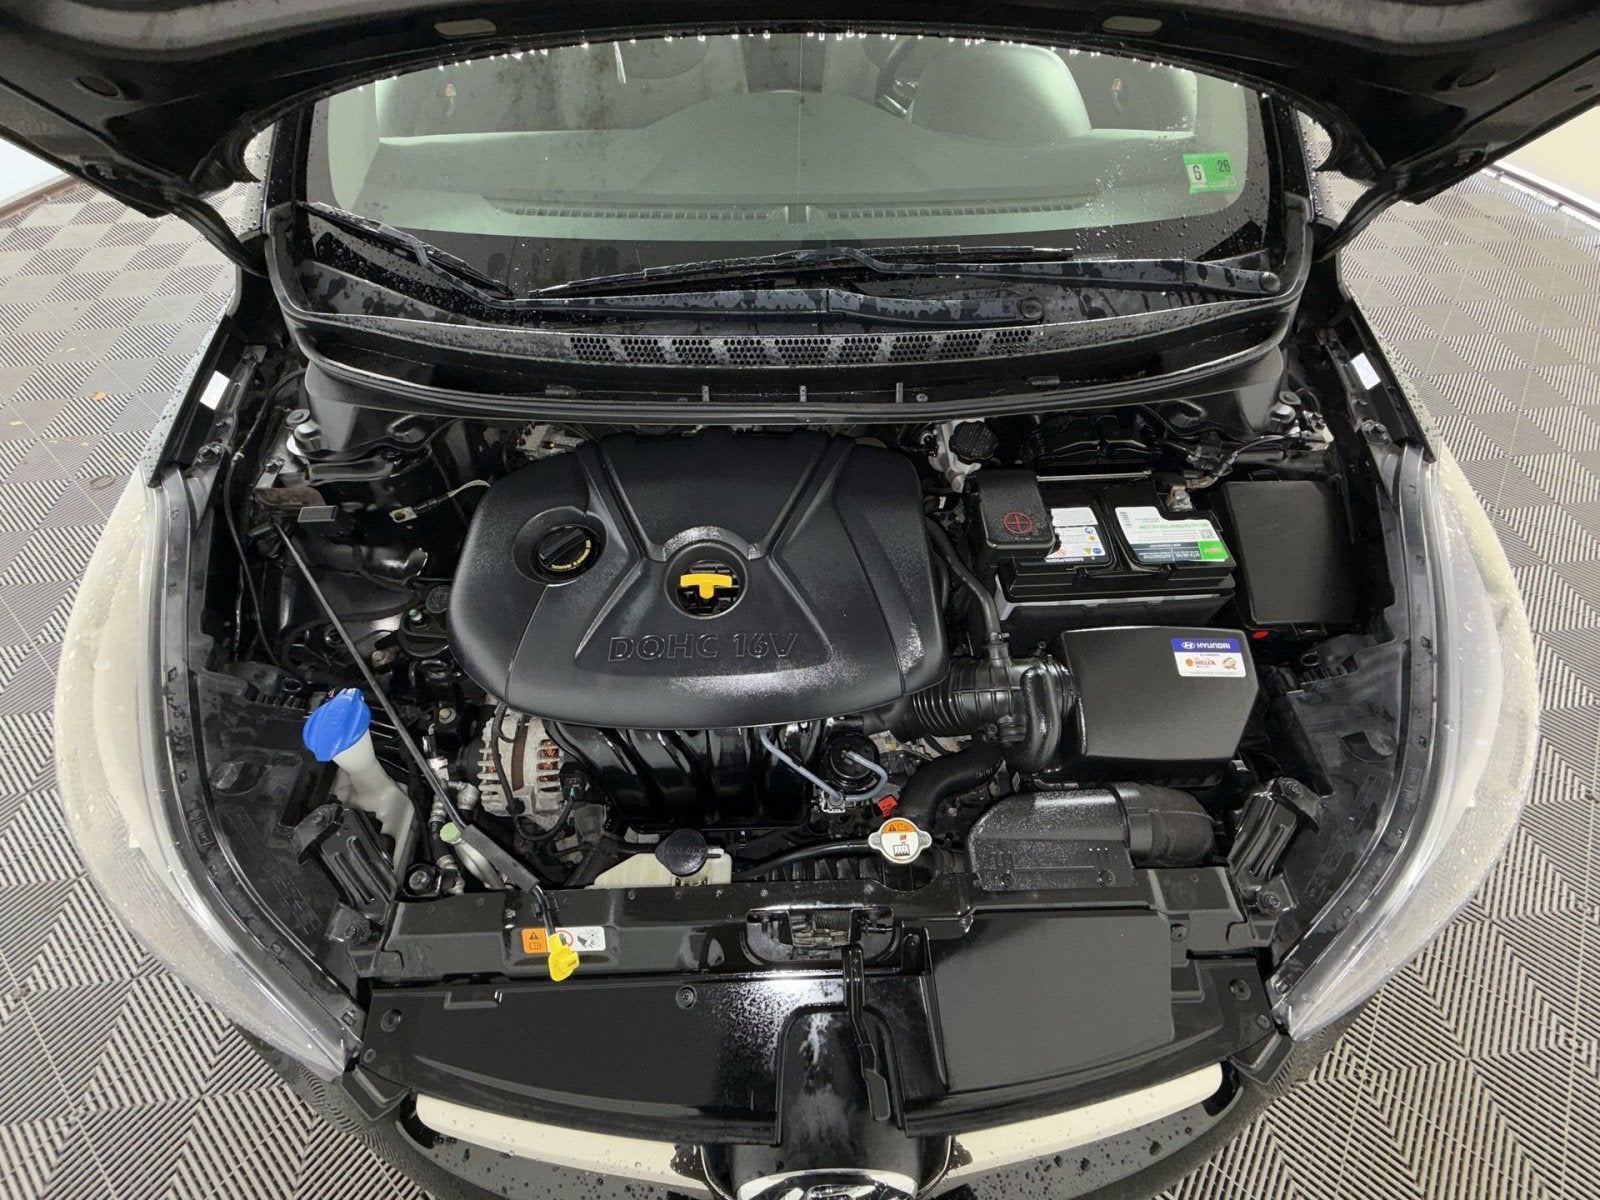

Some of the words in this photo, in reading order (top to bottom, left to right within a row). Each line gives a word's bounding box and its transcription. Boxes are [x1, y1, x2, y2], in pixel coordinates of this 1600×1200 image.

[1192, 164, 1202, 181] 6
[1216, 159, 1231, 173] 26
[608, 633, 719, 662] DOHC
[732, 632, 799, 659] 16V
[1196, 642, 1231, 650] HYUNDAI
